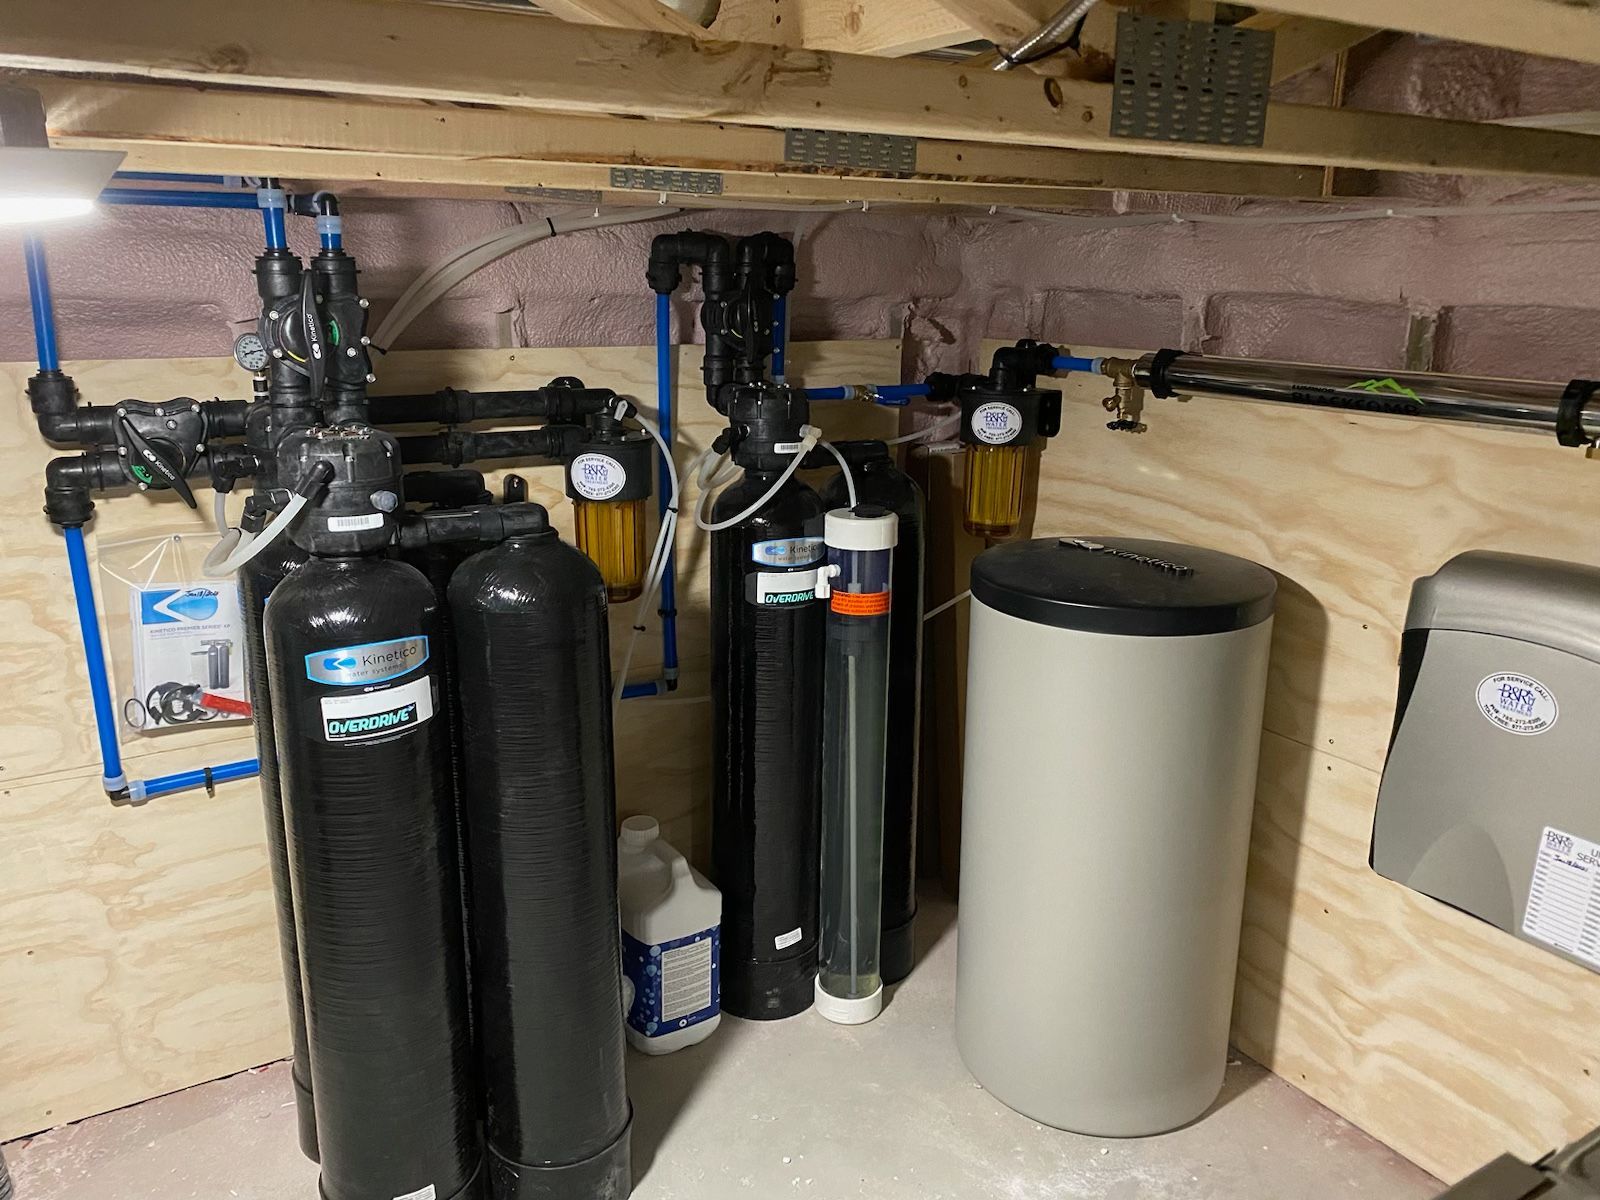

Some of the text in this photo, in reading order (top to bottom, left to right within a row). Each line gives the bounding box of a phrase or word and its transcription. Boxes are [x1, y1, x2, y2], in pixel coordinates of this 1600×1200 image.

[306, 313, 318, 342] Kinetico
[155, 460, 176, 480] Kinetico
[1104, 548, 1190, 575] Kinetico
[765, 590, 814, 604] OVERDRIVE
[362, 645, 418, 666] Kinetico
[1506, 676, 1534, 688] SERVICE
[1498, 683, 1532, 705] B&R
[1484, 704, 1494, 717] TOLL
[1500, 697, 1534, 712] WATER
[329, 708, 410, 735] OVERDRIVE
